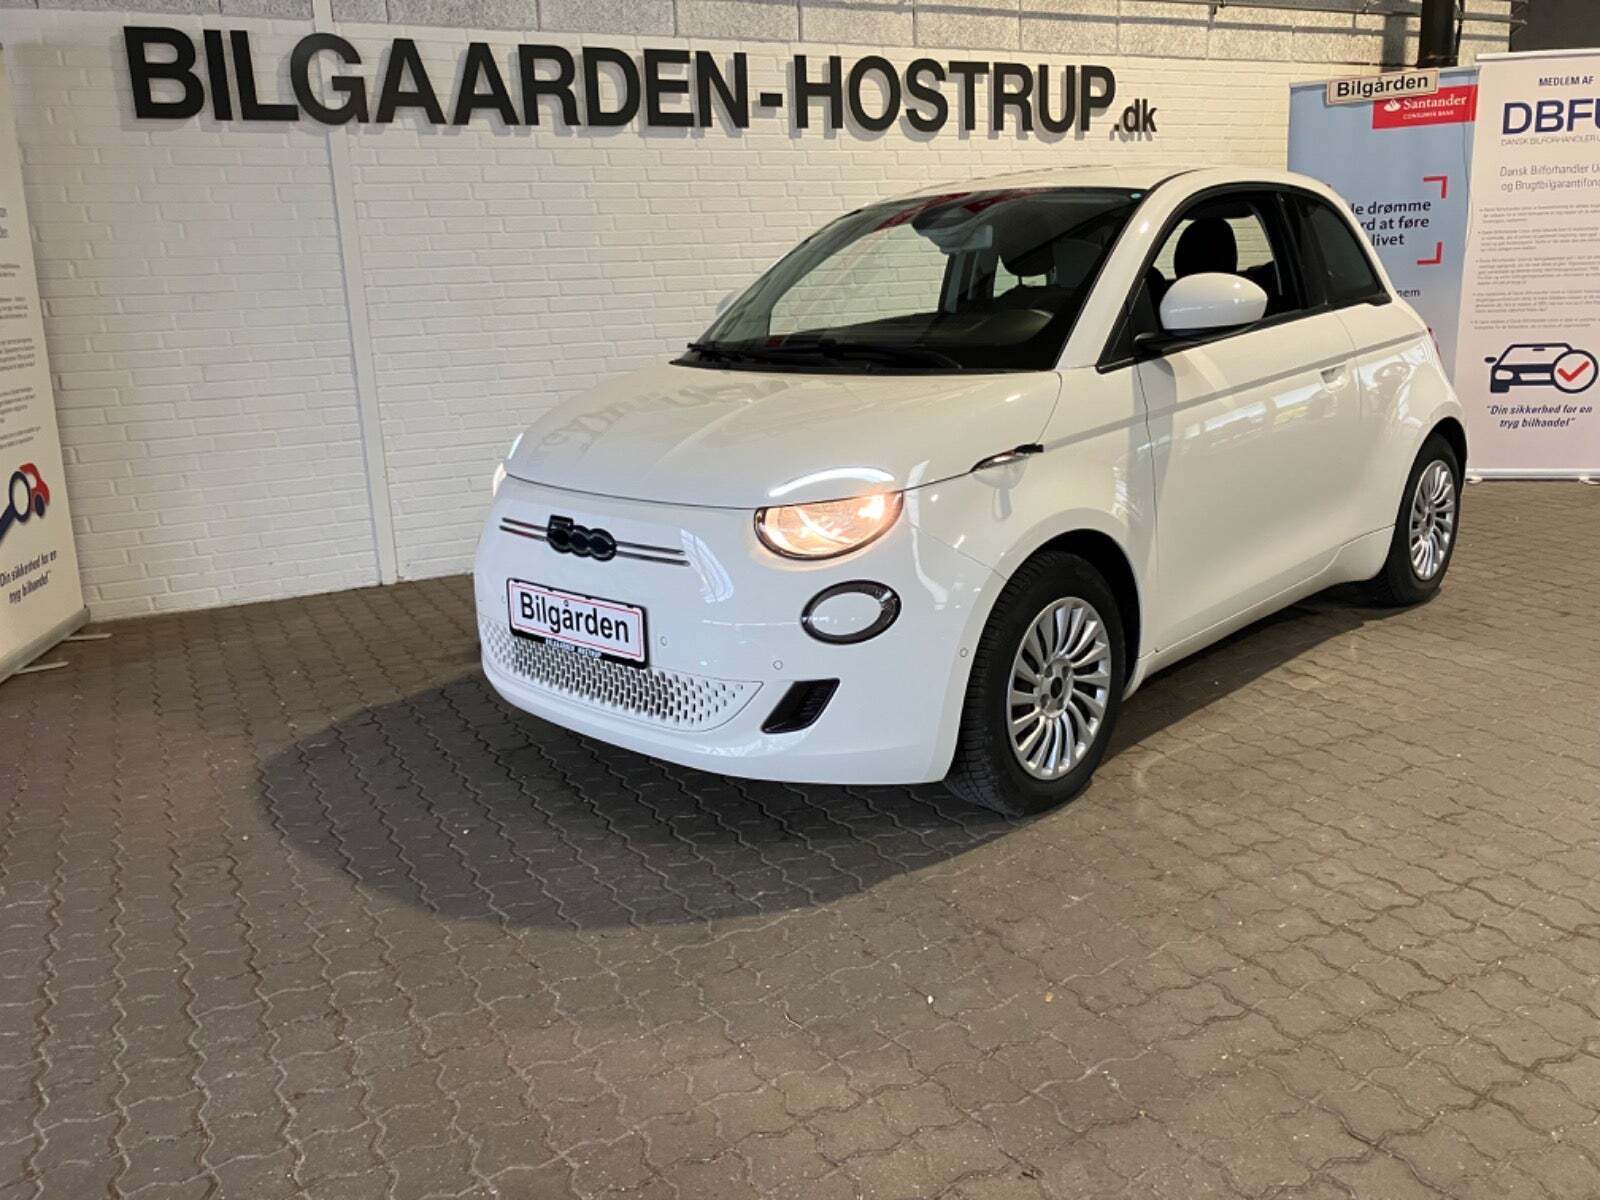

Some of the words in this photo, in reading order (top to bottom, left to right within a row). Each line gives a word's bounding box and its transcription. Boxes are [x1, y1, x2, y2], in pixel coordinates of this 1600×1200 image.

[1336, 75, 1429, 98] Bilgården
[1538, 76, 1580, 87] MEDLEM
[1582, 75, 1594, 85] AF
[1402, 93, 1467, 110] Santander
[1402, 111, 1436, 120] CONSUMER
[1502, 98, 1600, 135] DBF
[1500, 166, 1528, 177] Dansk
[1531, 163, 1589, 176] Bilforhandler
[1501, 182, 1513, 193] og
[1515, 178, 1600, 192] Brugtbilgarantifon
[1367, 200, 1431, 215] drømme
[1379, 217, 1394, 230] at
[1398, 216, 1430, 229] føre
[1372, 233, 1405, 246] livet
[1509, 403, 1561, 415] sikkerhed
[1563, 403, 1577, 414] for
[1579, 405, 1593, 414] en
[1499, 418, 1520, 429] tryg
[519, 591, 630, 643] Bilgården
